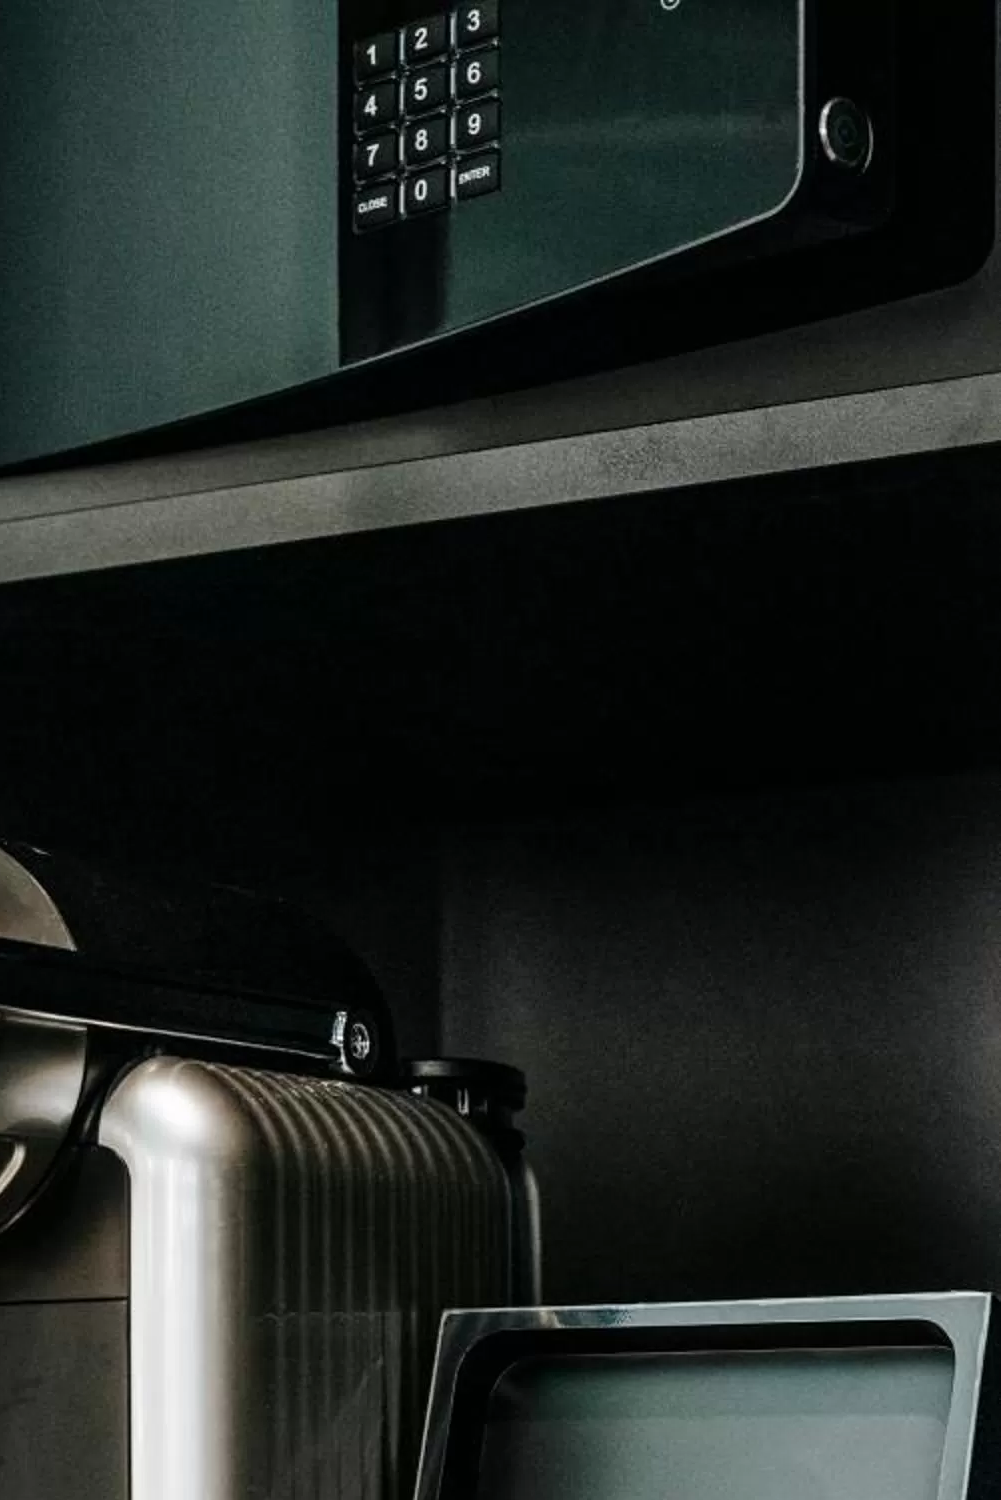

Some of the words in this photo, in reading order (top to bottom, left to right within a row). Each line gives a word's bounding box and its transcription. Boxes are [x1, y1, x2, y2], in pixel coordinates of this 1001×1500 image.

[366, 44, 377, 66] 1
[414, 27, 428, 50] 2
[466, 9, 481, 31] 3
[363, 94, 378, 117] 4
[414, 77, 428, 100] 5
[466, 61, 481, 84] 6
[366, 143, 380, 167] 7
[414, 129, 428, 151] 8
[467, 113, 481, 135] 9
[414, 179, 428, 200] 0
[458, 165, 490, 185] ENTER
